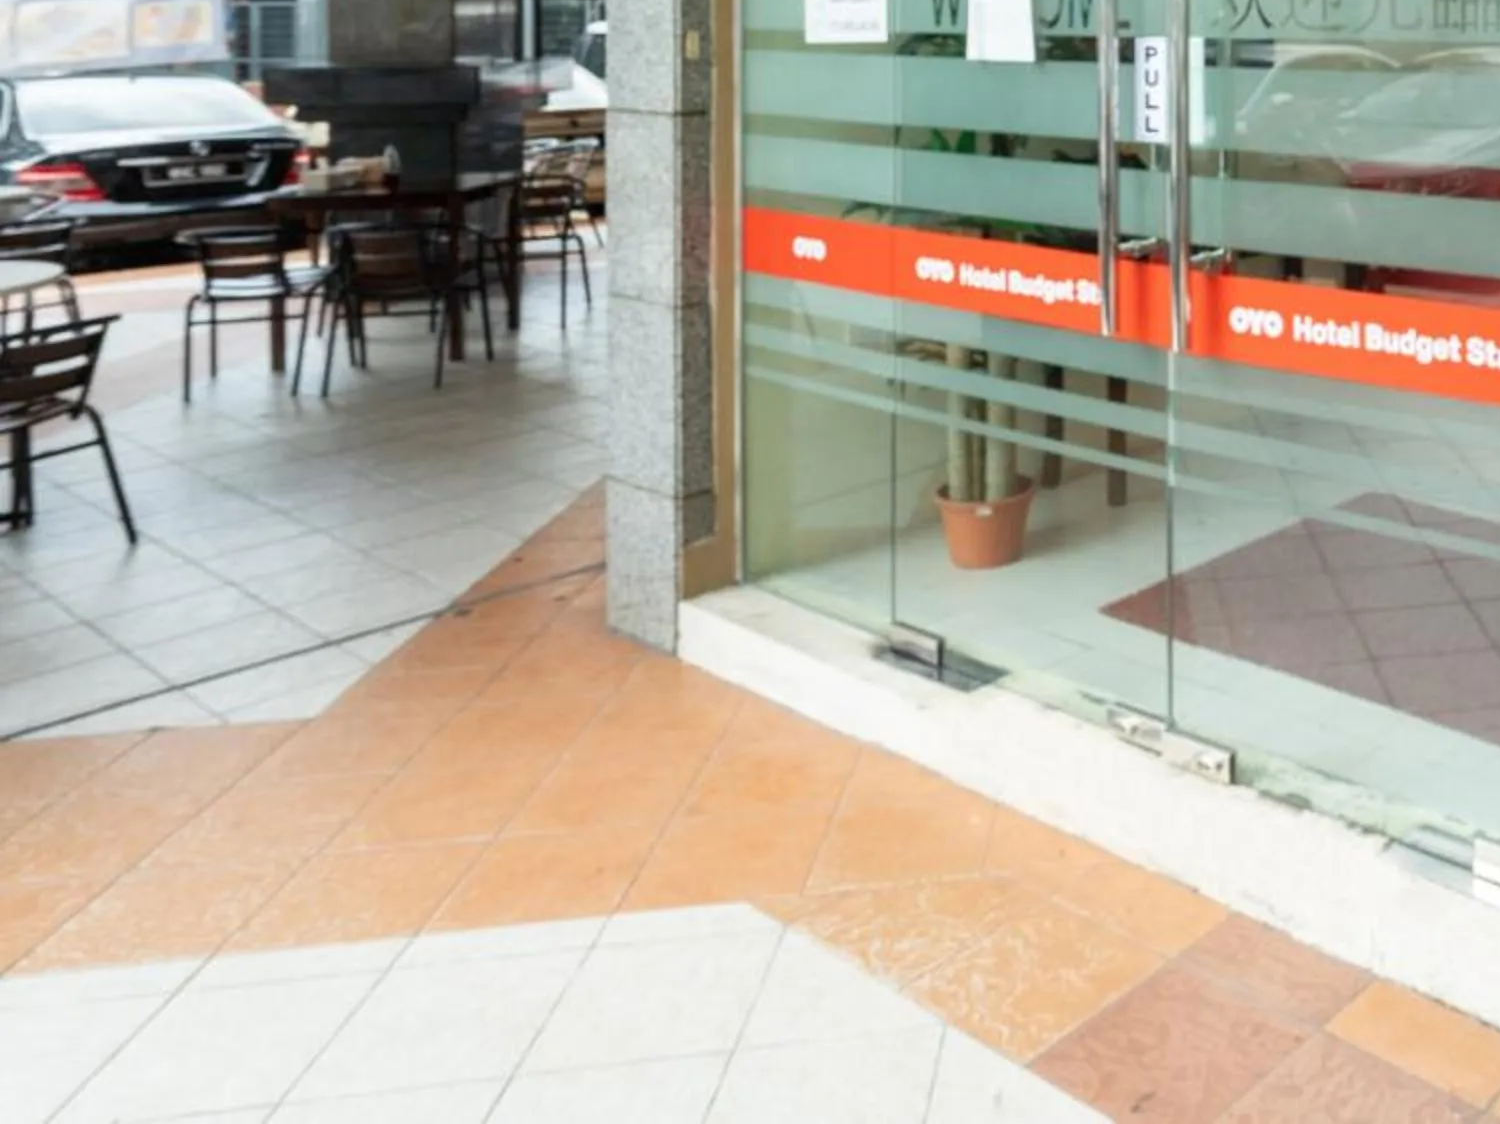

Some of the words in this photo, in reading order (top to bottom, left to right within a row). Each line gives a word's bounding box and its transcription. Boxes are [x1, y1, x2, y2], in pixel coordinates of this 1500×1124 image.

[1144, 45, 1160, 134] PULL
[792, 236, 827, 261] OYO
[915, 256, 954, 282] OYO
[959, 263, 1006, 292] Hotel
[1009, 267, 1074, 304] Budget
[1076, 280, 1102, 305] St
[1229, 306, 1283, 338] OYO
[1292, 315, 1360, 349] Hotel
[1364, 322, 1462, 364] Budget
